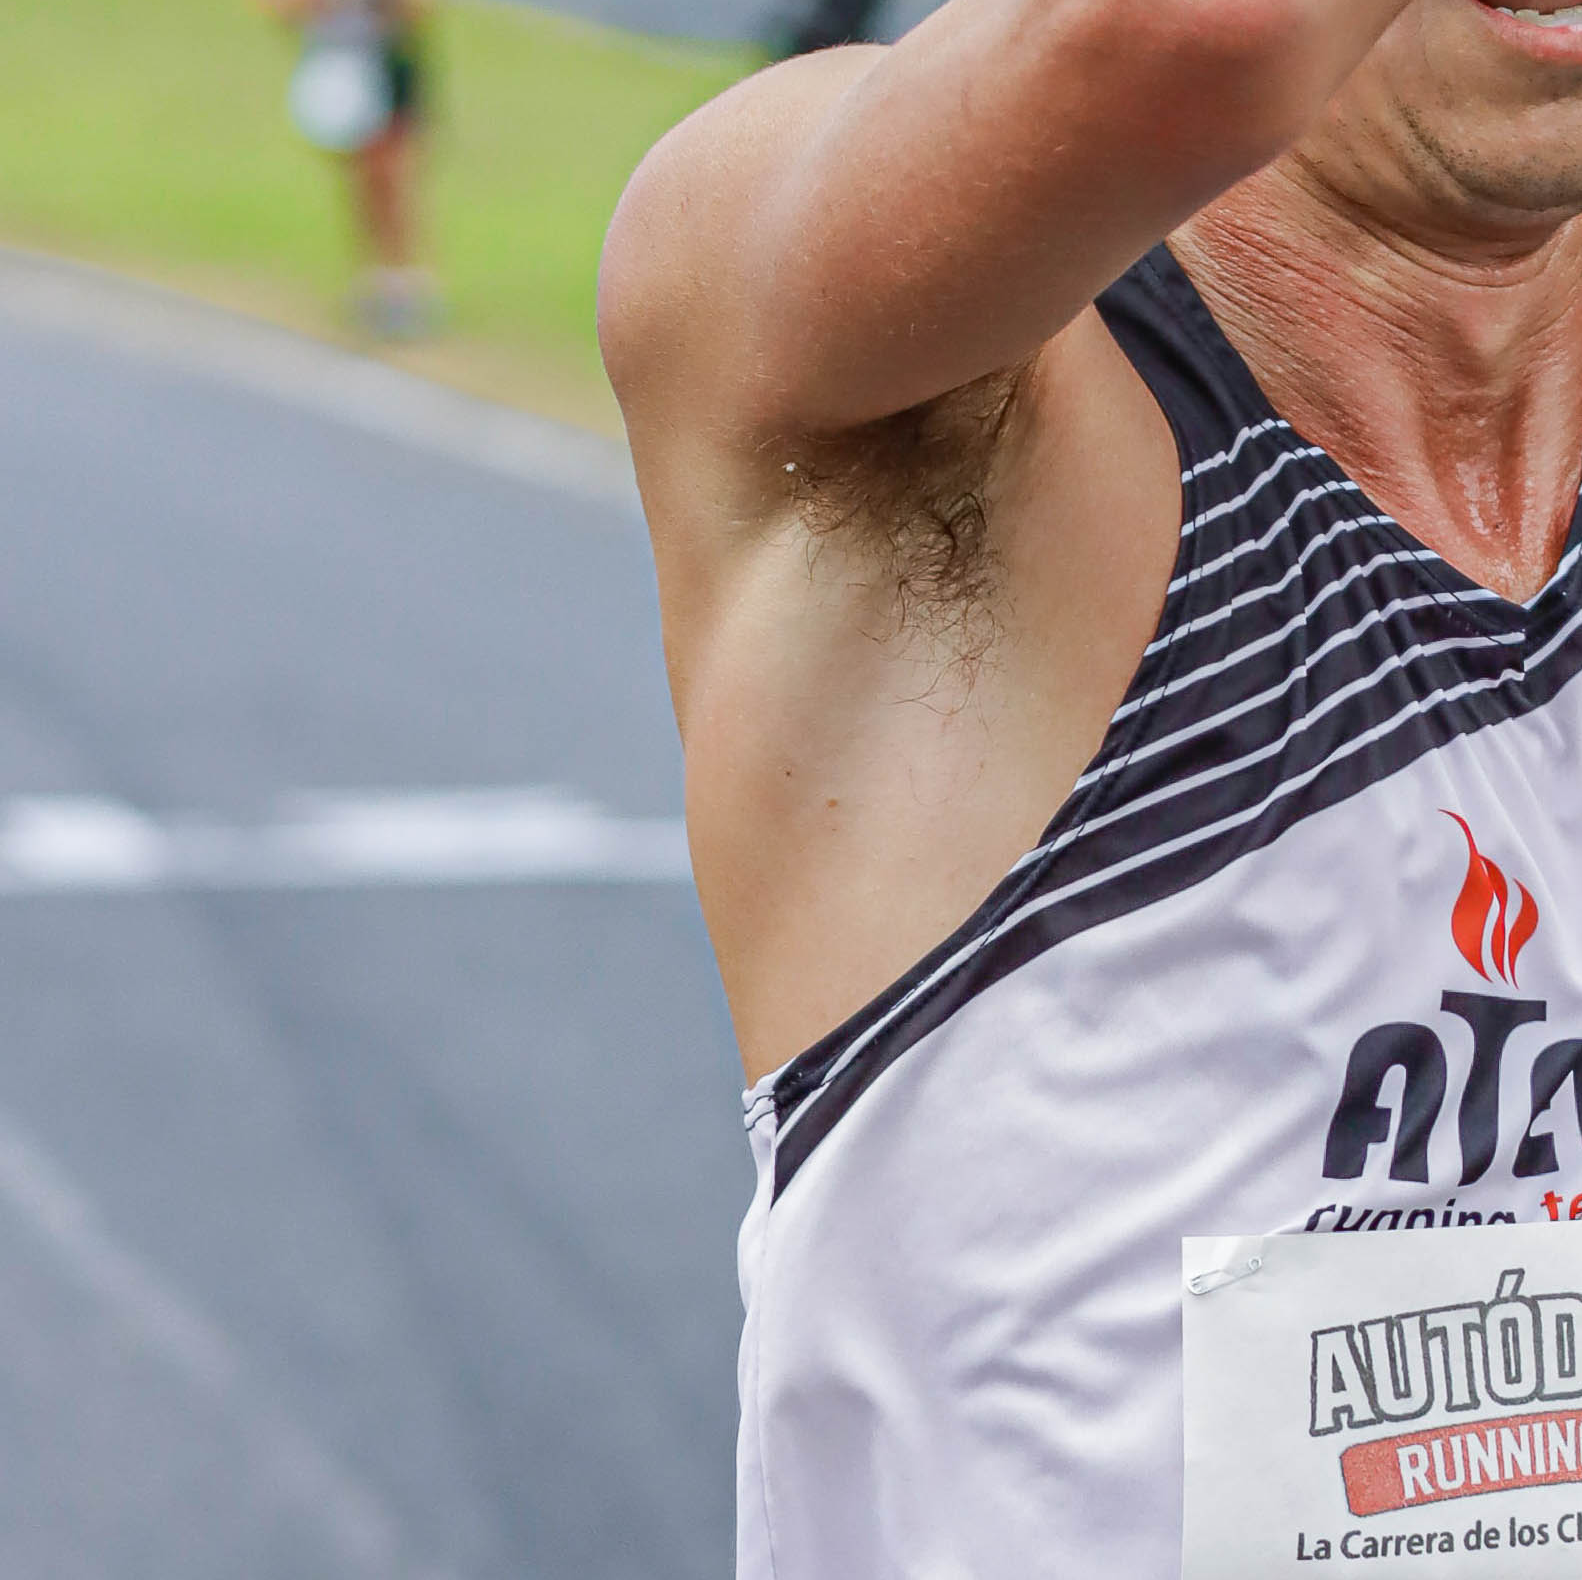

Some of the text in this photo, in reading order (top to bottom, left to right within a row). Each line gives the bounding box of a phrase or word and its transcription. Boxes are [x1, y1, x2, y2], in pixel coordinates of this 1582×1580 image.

[1296, 1532, 1332, 1561] La
[1340, 1529, 1455, 1560] Carrera
[1463, 1519, 1501, 1551] de
[1509, 1516, 1550, 1548] los
